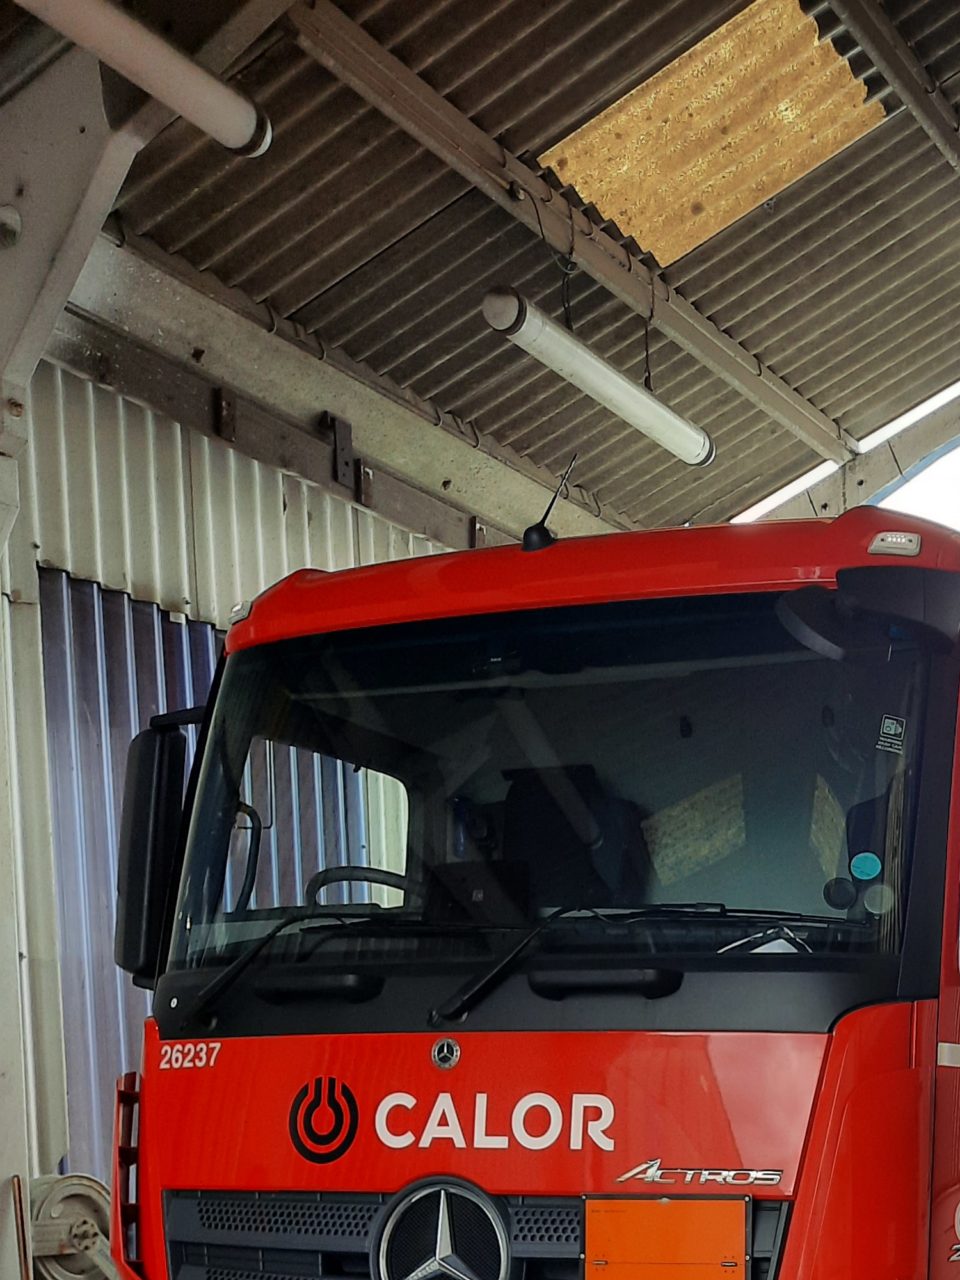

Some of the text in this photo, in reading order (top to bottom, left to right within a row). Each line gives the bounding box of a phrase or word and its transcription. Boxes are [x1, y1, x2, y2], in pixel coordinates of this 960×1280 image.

[159, 1042, 222, 1069] 26237
[375, 1092, 615, 1151] CALOR
[615, 1158, 784, 1187] ACTROS
